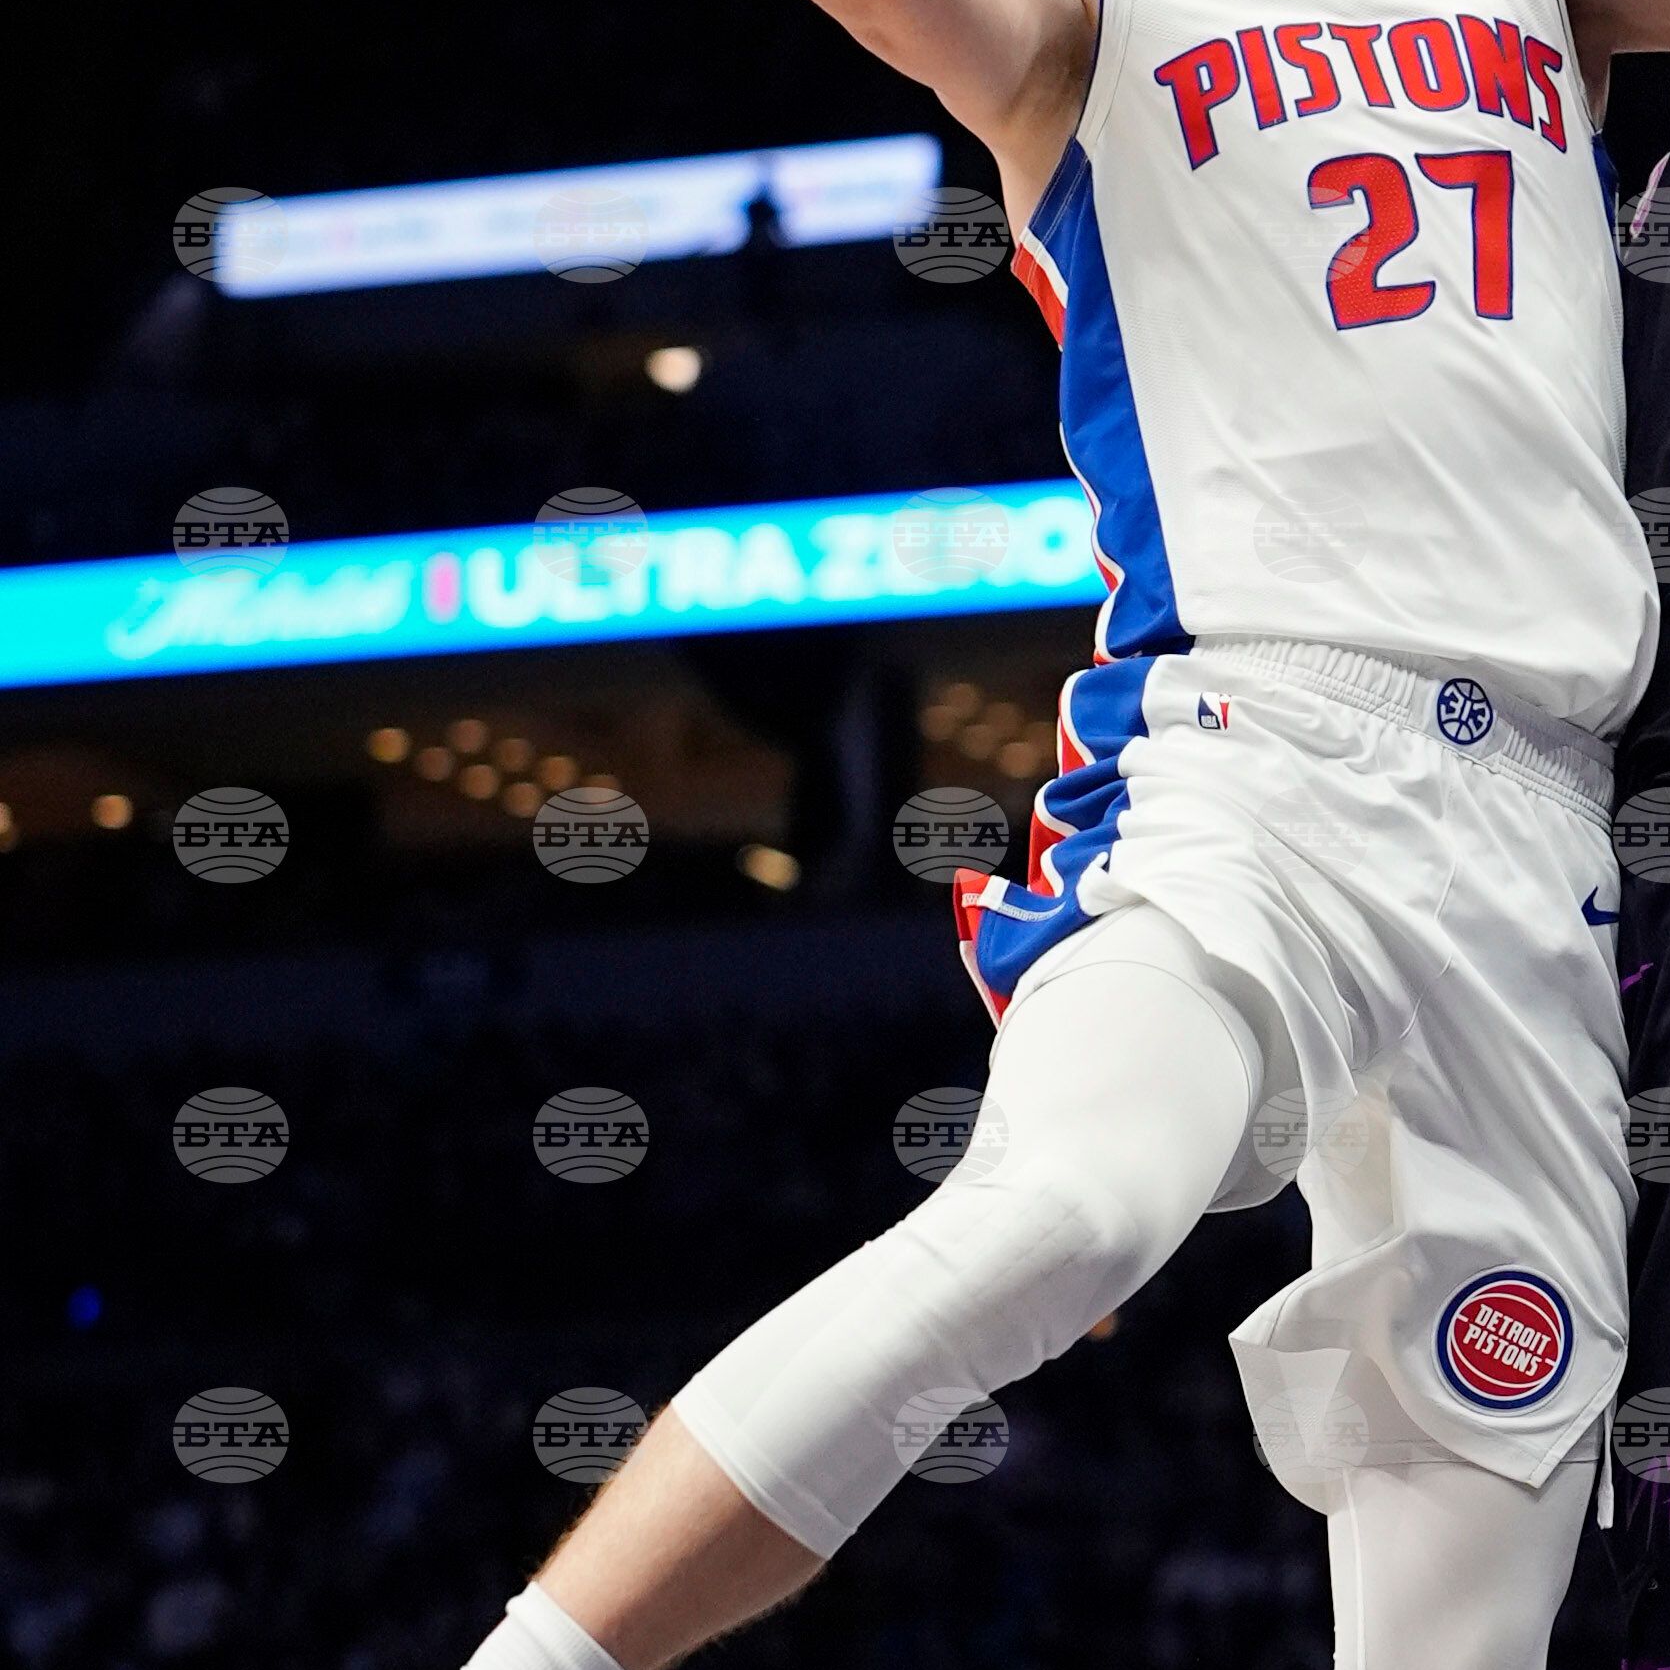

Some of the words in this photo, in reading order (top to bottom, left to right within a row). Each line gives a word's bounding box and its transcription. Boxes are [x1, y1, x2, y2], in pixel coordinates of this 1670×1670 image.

[1154, 13, 1568, 170] PISTONS
[1308, 150, 1514, 331] 27
[1462, 1323, 1543, 1377] PISTONS
[1474, 1303, 1552, 1356] DETROIT
